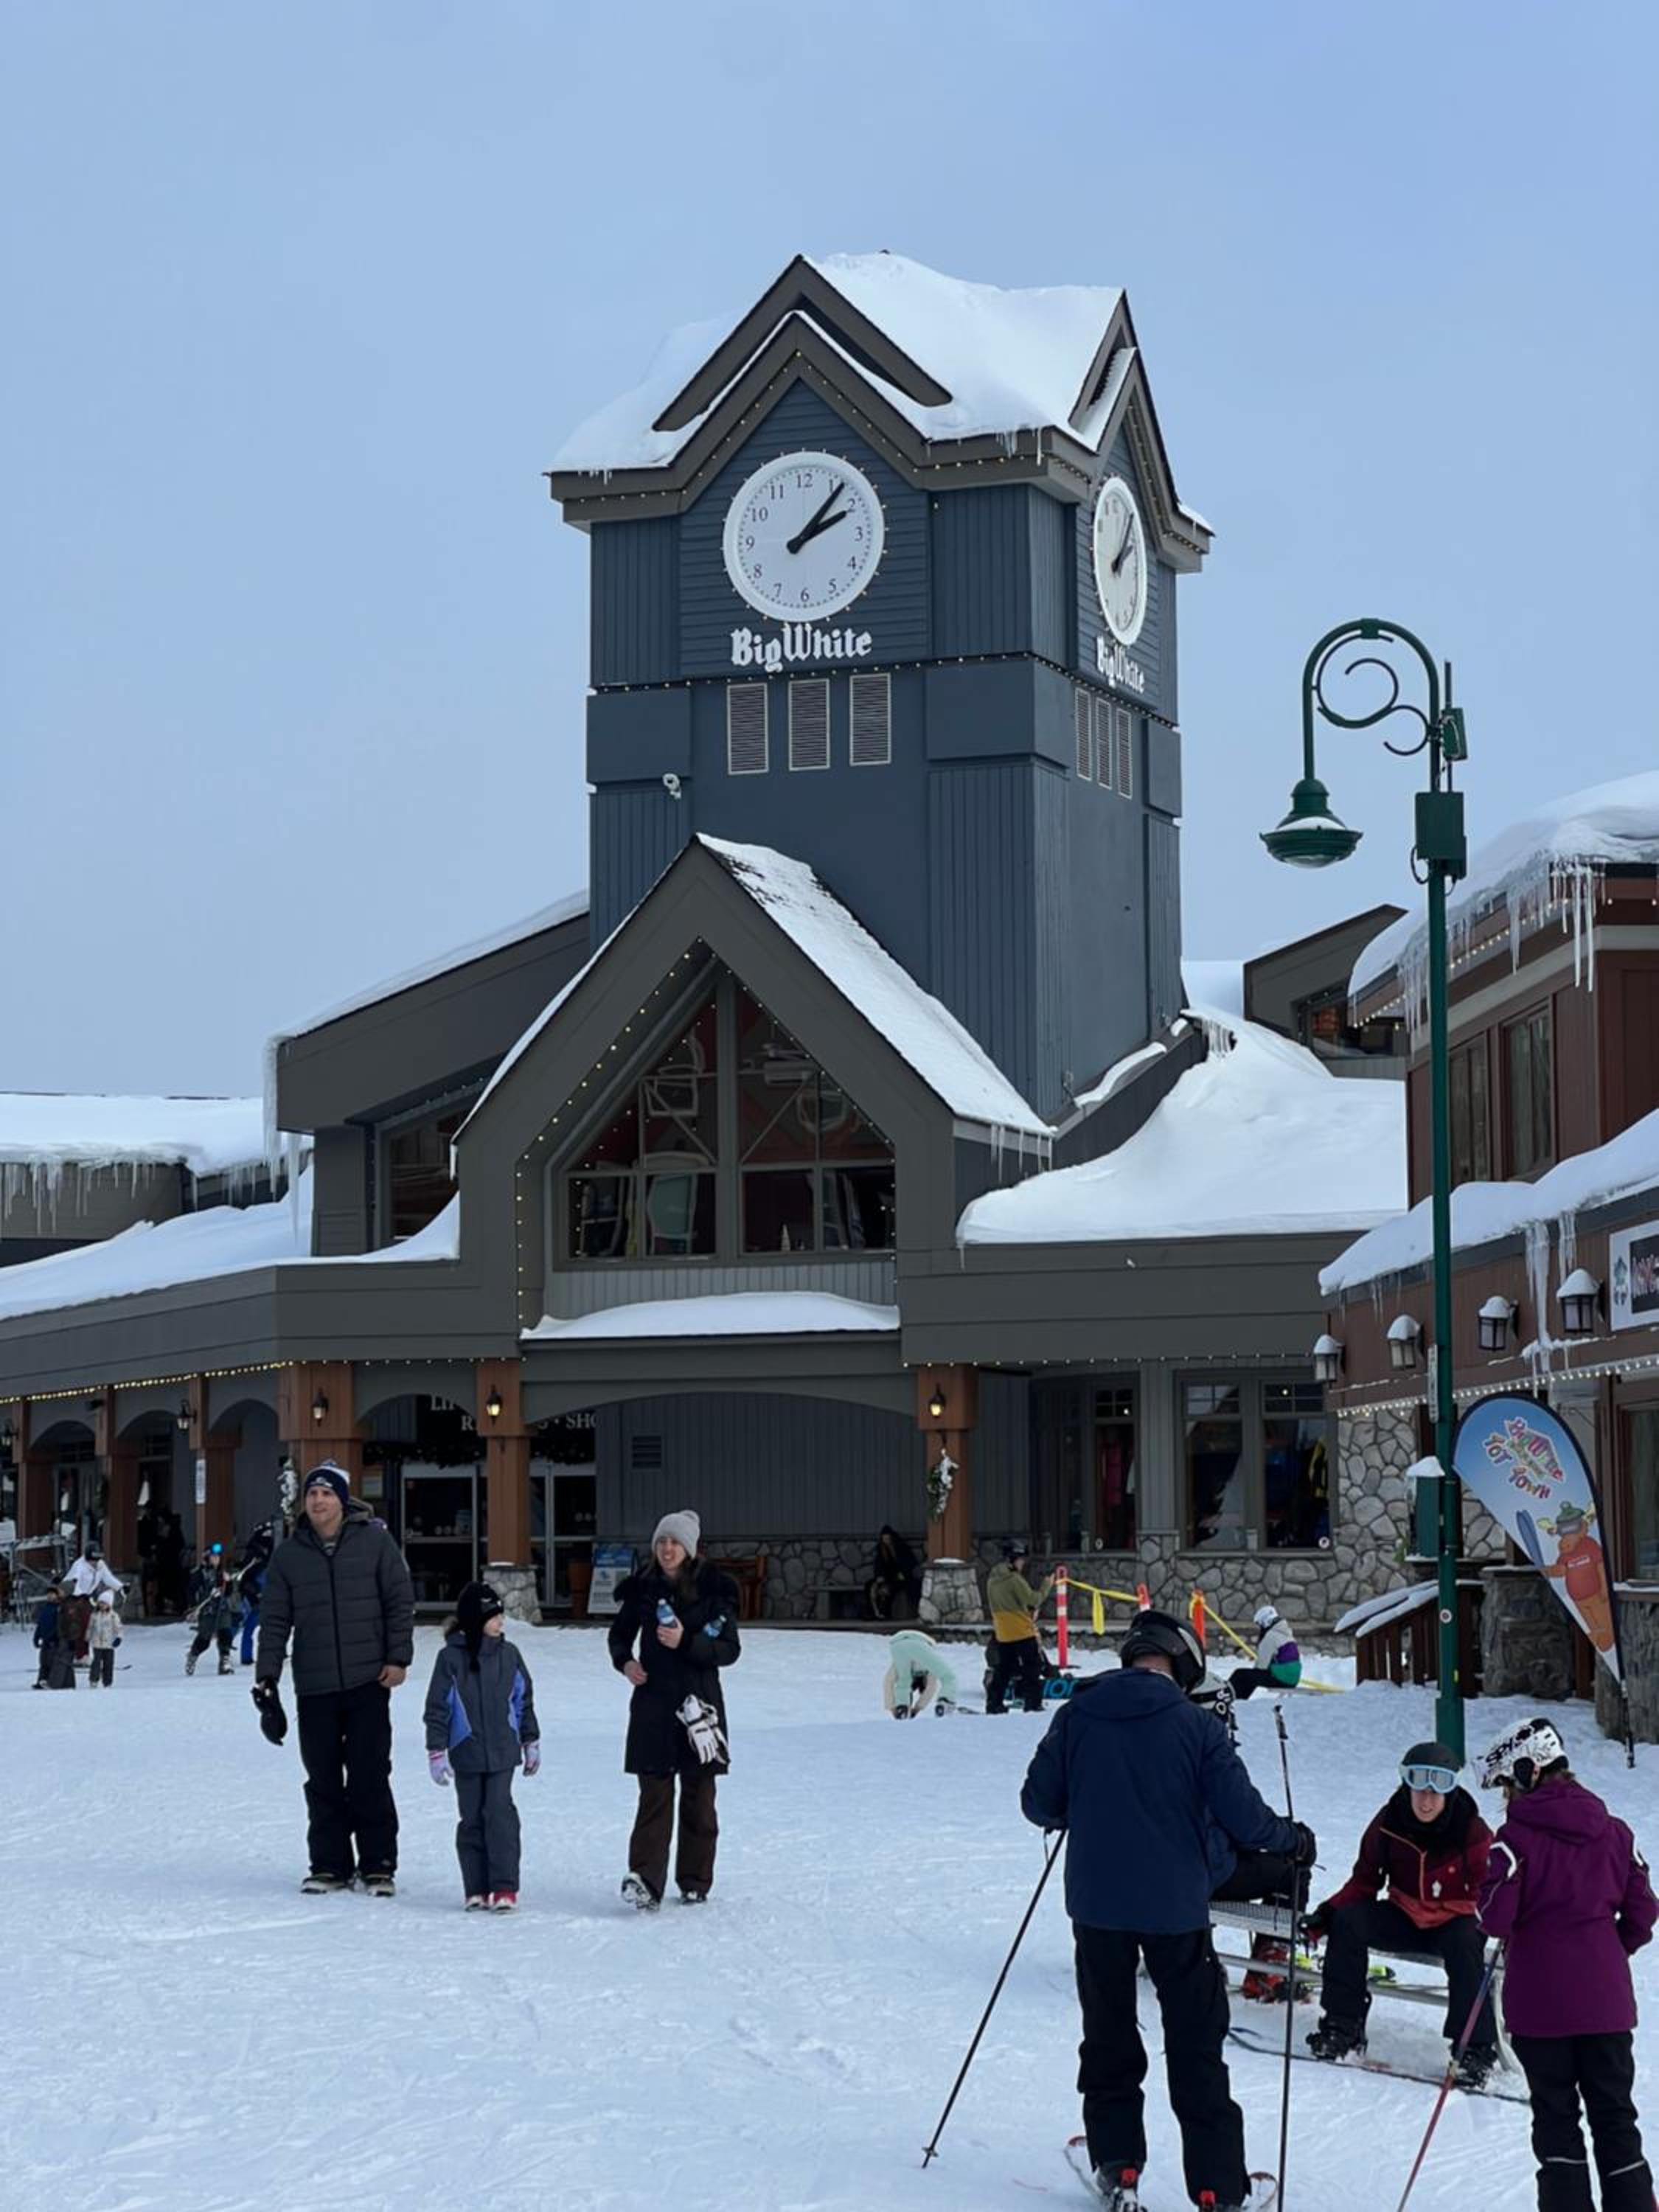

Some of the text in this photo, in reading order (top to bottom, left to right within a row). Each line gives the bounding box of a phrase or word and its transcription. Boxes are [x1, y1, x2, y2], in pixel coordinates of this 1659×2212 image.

[796, 473, 813, 489] 12
[770, 484, 784, 500] 11
[847, 498, 856, 513] 2
[751, 508, 768, 522] 10
[855, 526, 863, 541] 3
[745, 536, 754, 551] 9
[847, 556, 856, 571] 4
[754, 566, 762, 580] 8
[773, 583, 782, 598] 7
[829, 579, 837, 594] 5
[800, 588, 810, 603] 6
